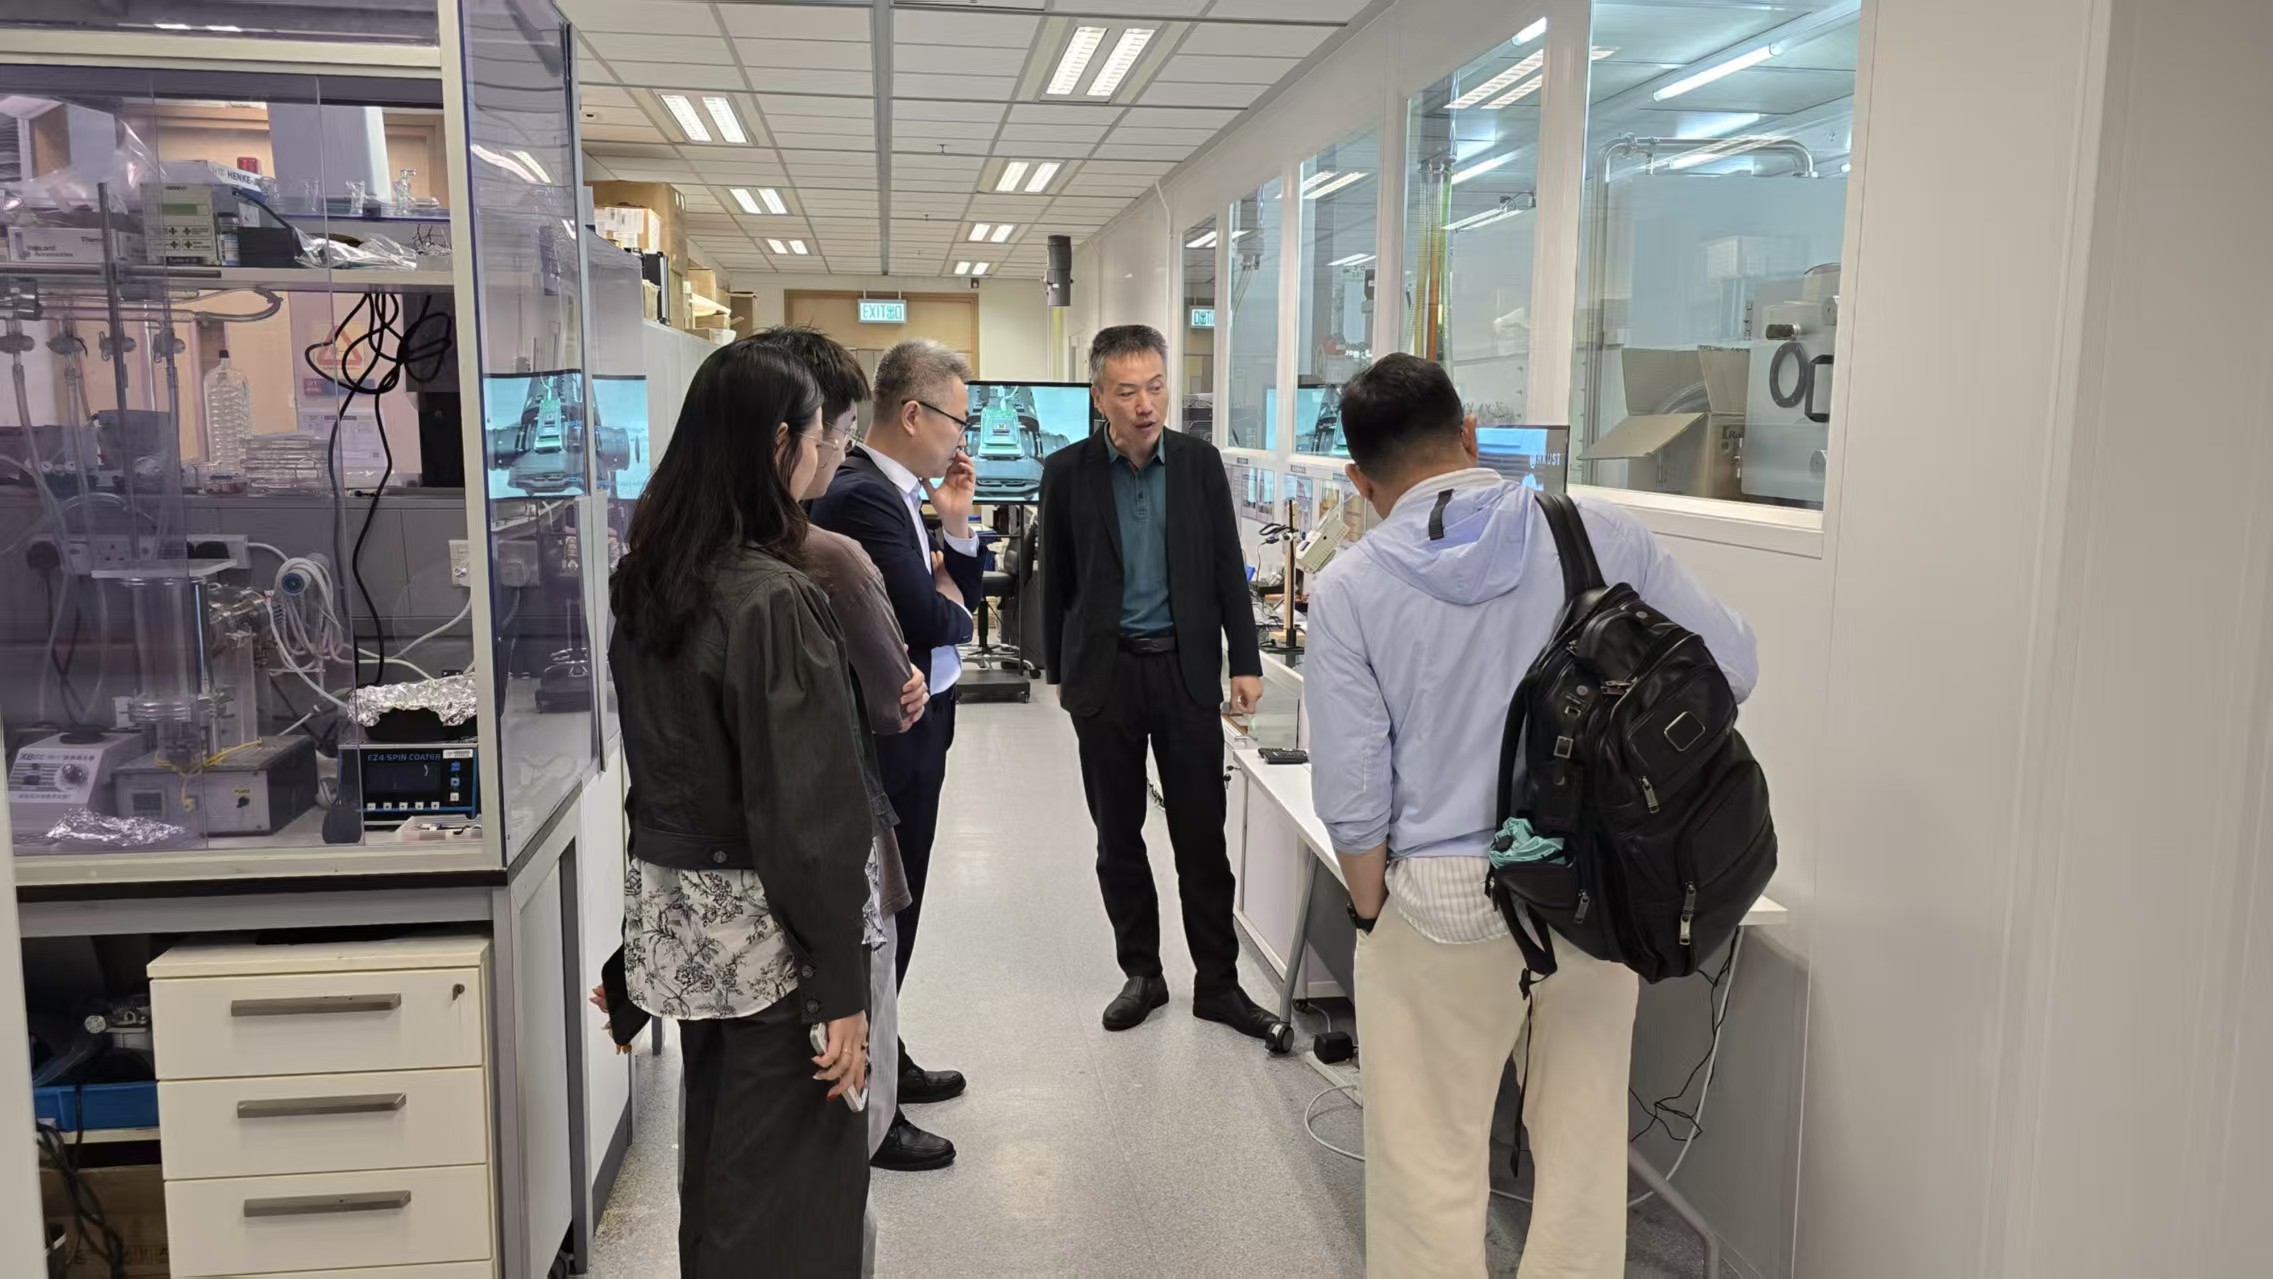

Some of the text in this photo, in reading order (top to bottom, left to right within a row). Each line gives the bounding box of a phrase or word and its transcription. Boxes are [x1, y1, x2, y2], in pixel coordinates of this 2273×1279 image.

[863, 304, 902, 319] EXIT 出口
[408, 753, 440, 761] COATER
